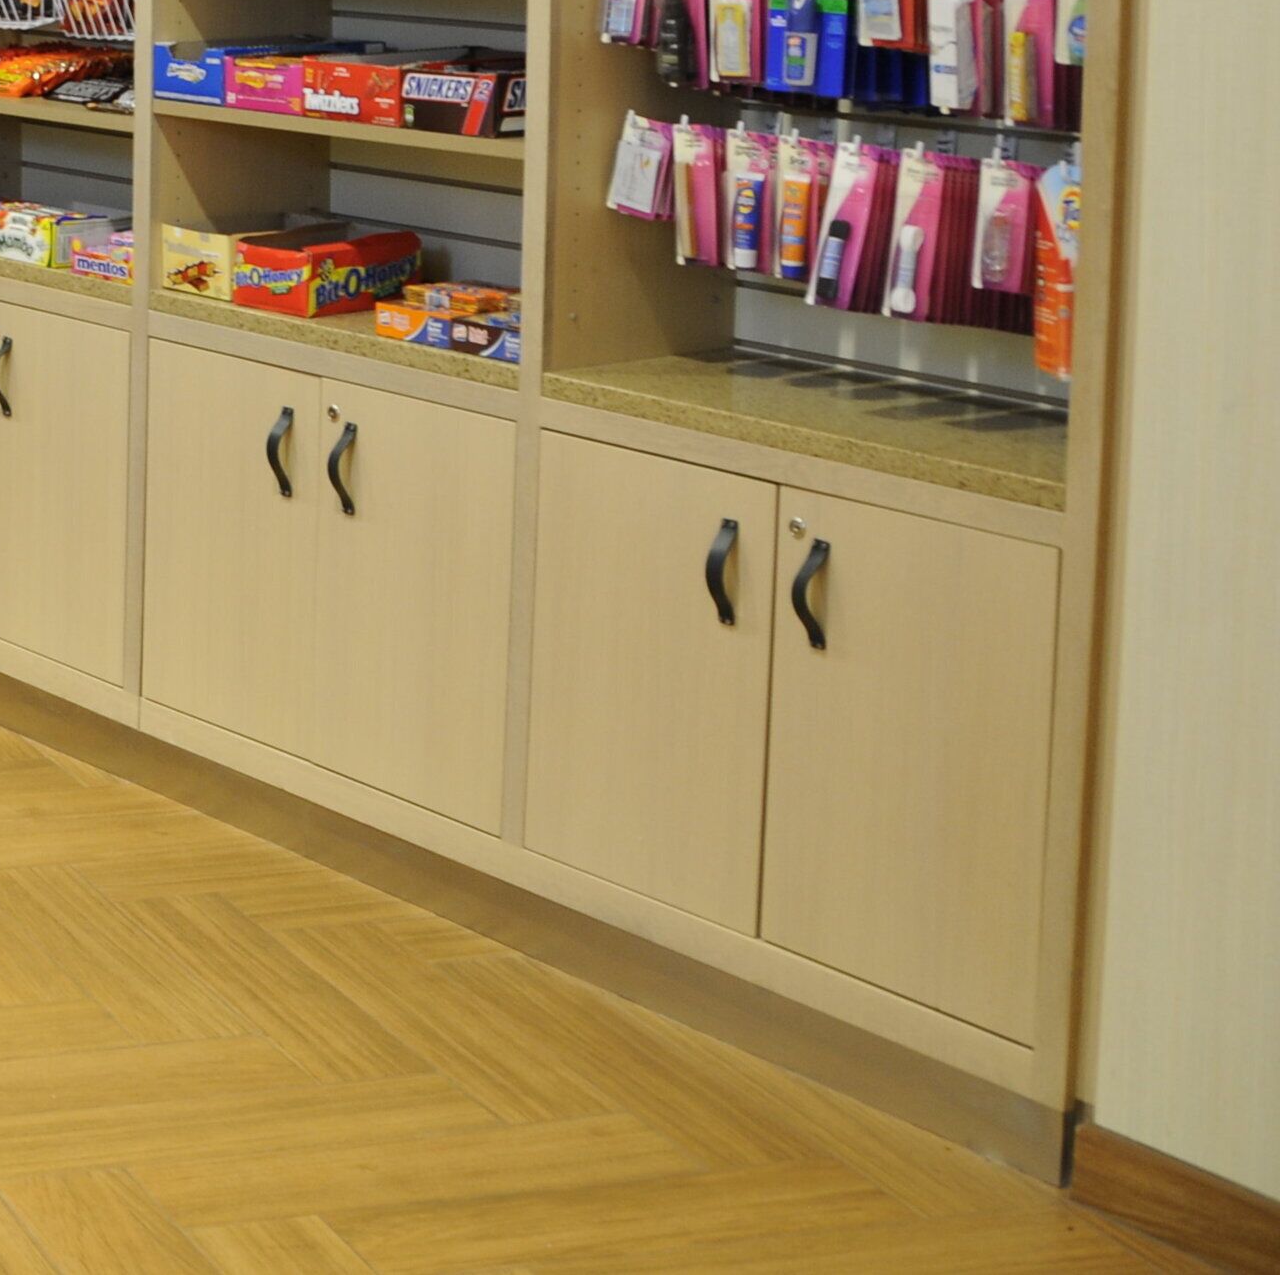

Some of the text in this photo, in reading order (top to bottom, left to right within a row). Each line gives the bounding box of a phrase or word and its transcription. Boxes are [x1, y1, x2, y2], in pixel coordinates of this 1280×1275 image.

[406, 75, 472, 101] SNICKERS
[302, 87, 360, 115] Twizzlers
[76, 256, 128, 277] mentos
[235, 266, 304, 287] Bit-O-Honey
